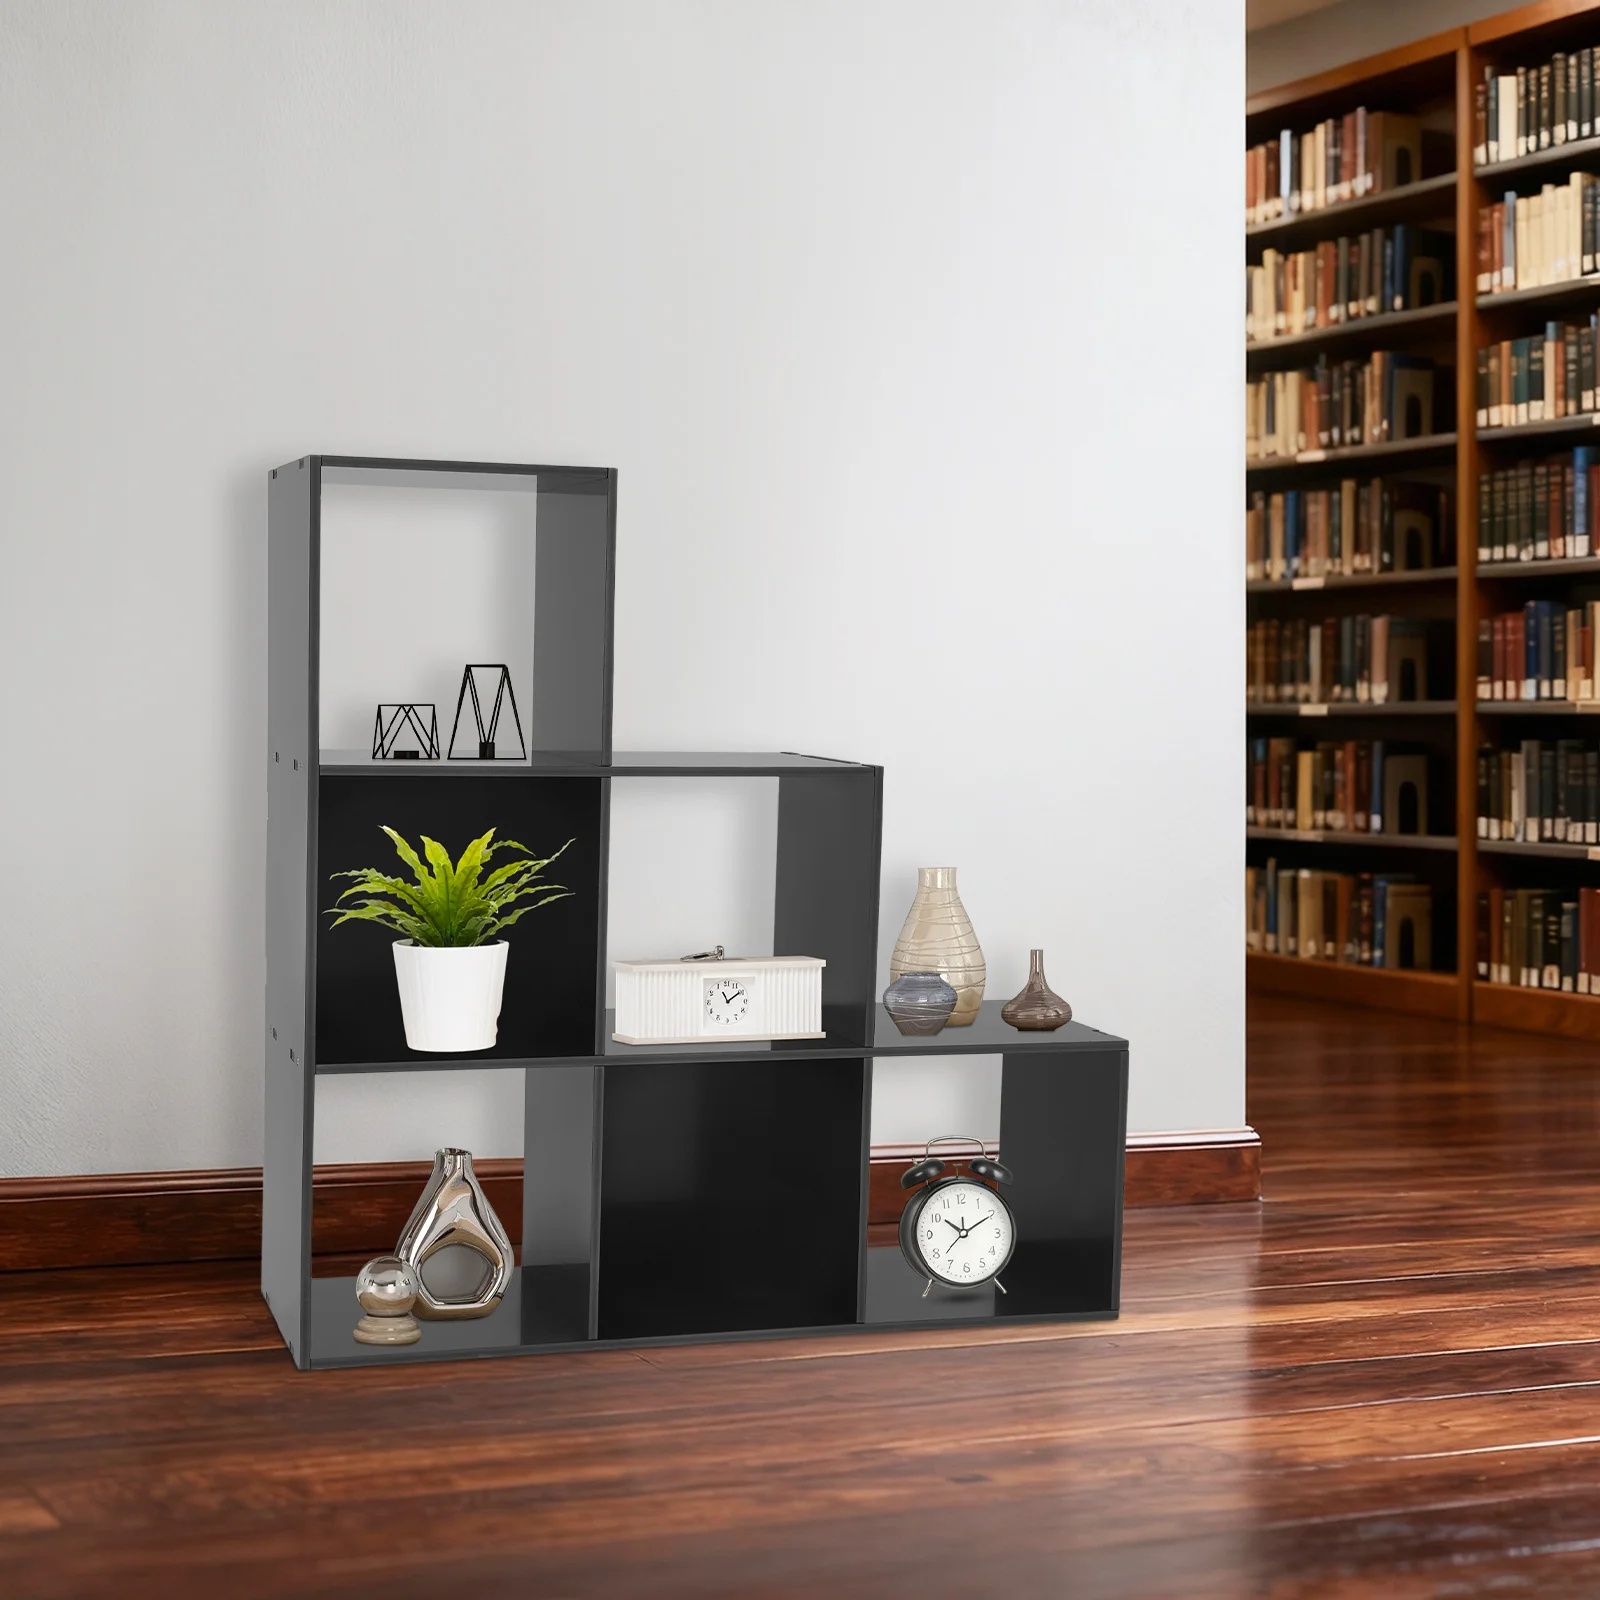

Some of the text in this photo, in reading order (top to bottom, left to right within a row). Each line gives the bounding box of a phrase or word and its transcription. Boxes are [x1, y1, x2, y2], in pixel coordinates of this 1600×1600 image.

[956, 1193, 966, 1204] 12
[976, 1198, 980, 1209] 1
[943, 1199, 950, 1209] 11
[932, 1214, 941, 1223] 10
[994, 1228, 1000, 1239] 3
[933, 1248, 940, 1259] 8
[988, 1246, 995, 1255] 4
[948, 1260, 954, 1269] 7
[963, 1262, 970, 1273] 6
[980, 1258, 985, 1268] 5
